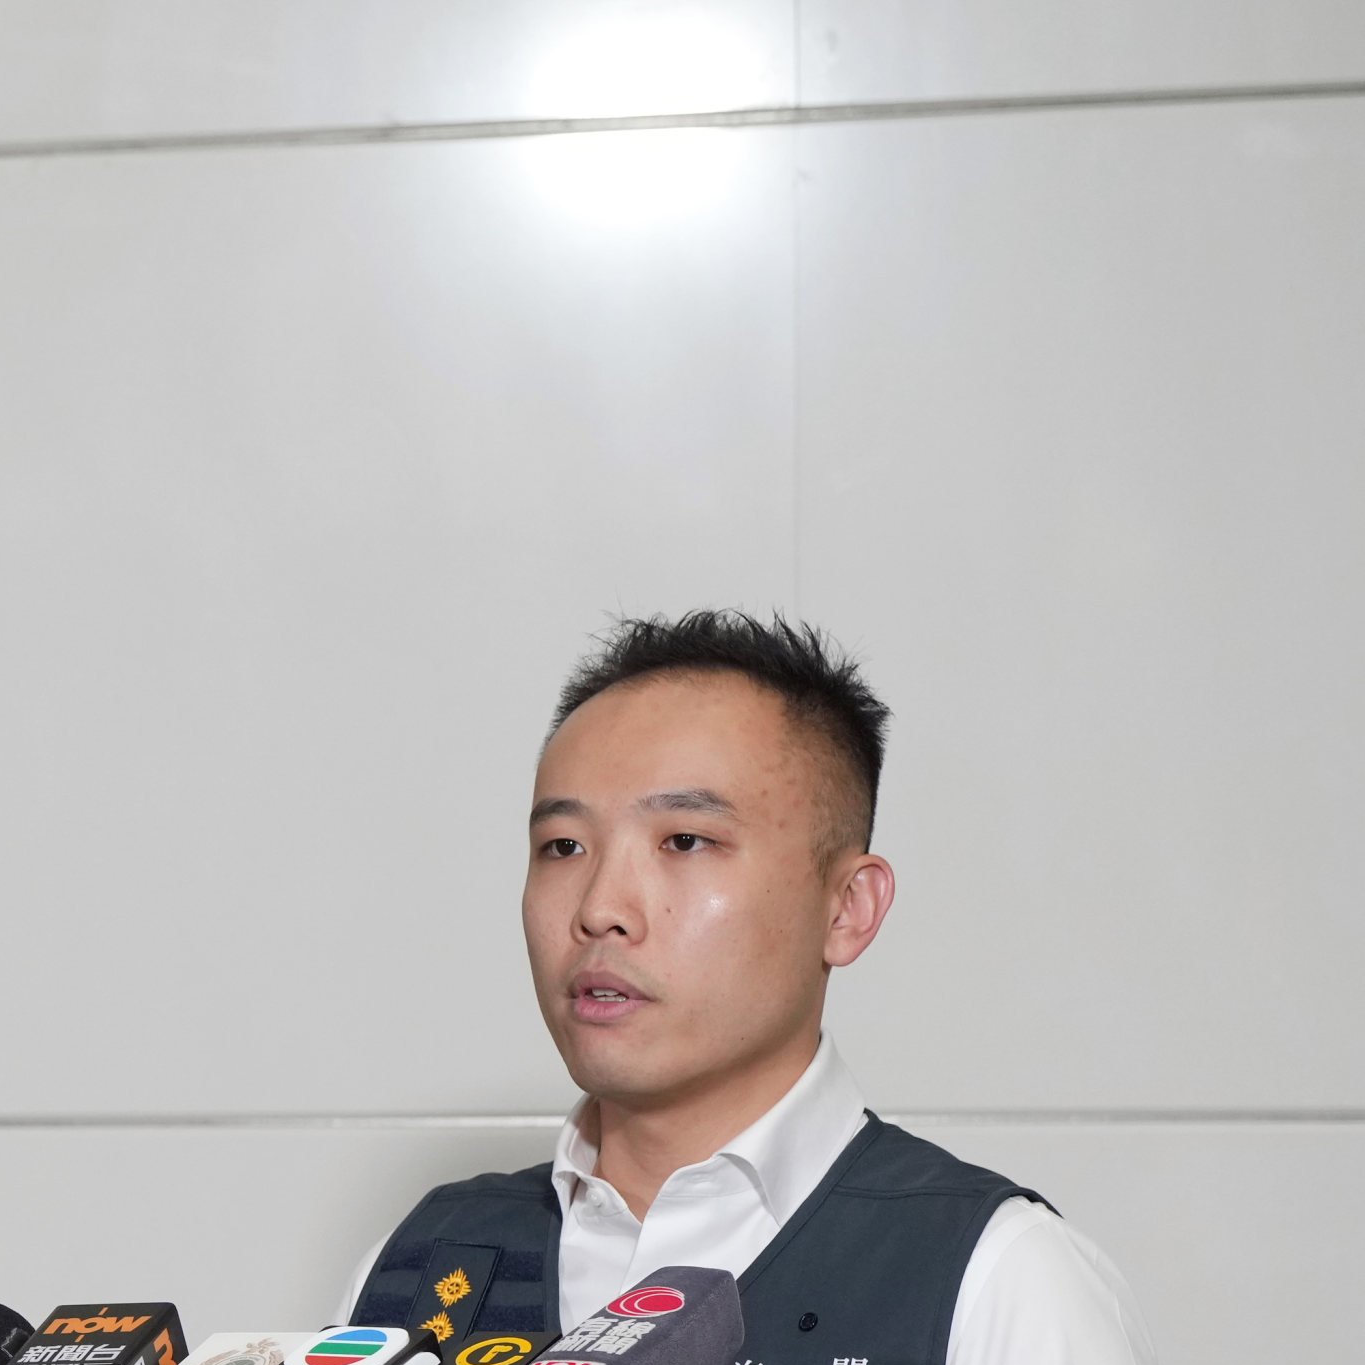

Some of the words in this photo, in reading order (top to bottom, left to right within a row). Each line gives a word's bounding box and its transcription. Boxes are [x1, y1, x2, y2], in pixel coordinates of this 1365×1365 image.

[43, 1311, 152, 1338] now
[18, 1343, 127, 1364] 新聞台
